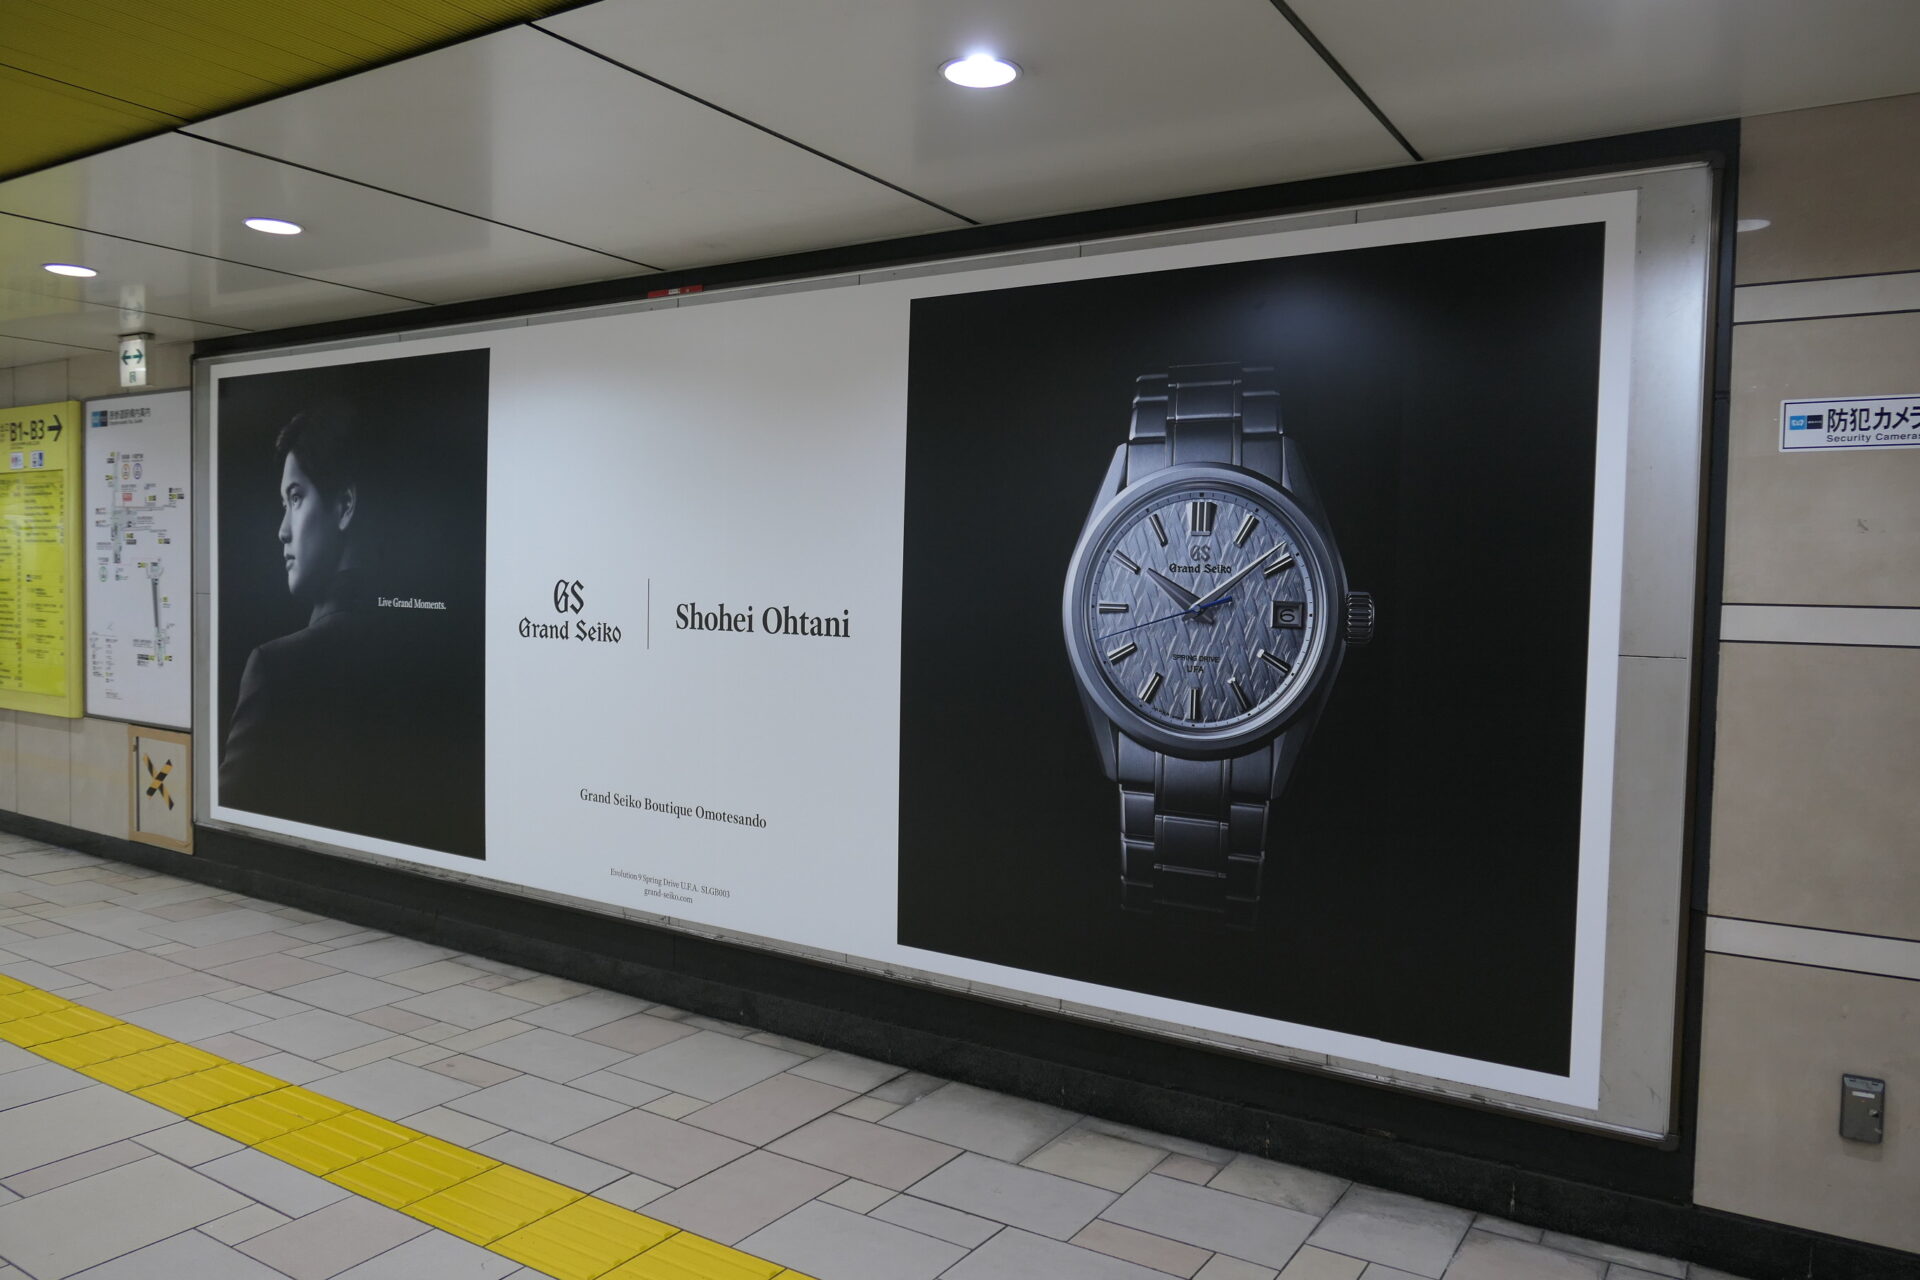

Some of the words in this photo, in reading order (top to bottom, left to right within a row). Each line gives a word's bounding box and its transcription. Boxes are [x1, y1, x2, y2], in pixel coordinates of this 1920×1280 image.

[1827, 406, 1920, 433] 防犯カメラ
[1826, 433, 1872, 443] Security
[1169, 563, 1201, 574] Grand
[1204, 564, 1232, 574] Seiko
[378, 597, 392, 607] Live
[393, 598, 413, 608] Grand
[414, 599, 446, 610] Moments.
[553, 579, 584, 615] GS
[519, 617, 569, 640] Grand
[575, 619, 621, 643] Seiko
[676, 603, 754, 632] Shohei
[762, 606, 850, 638] Ohtani
[1172, 654, 1198, 662] SPRING
[1199, 655, 1221, 663] DRIVE
[580, 788, 611, 804] Grand
[613, 793, 642, 809] Seiko
[644, 797, 693, 819] Boutique
[695, 805, 767, 828] Omotesando
[610, 868, 638, 880] Evolution
[642, 874, 662, 887] Spring
[663, 878, 680, 889] Drive
[644, 887, 693, 904] grand-seiko.com
